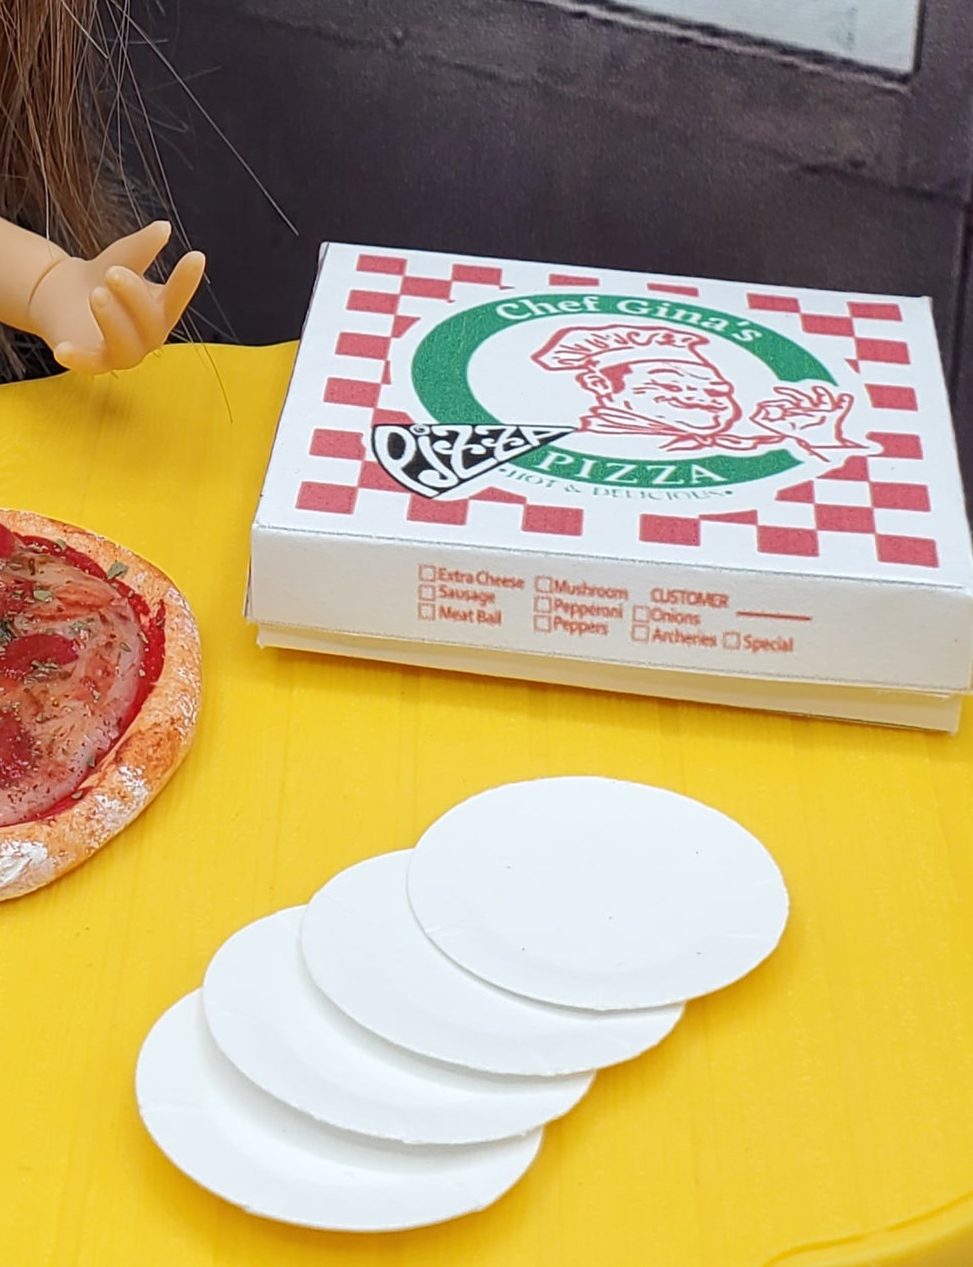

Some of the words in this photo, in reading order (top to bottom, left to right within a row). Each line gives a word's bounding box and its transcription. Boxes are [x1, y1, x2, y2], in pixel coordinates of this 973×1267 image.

[495, 295, 601, 322] Chef
[616, 299, 763, 343] Gina's
[534, 450, 729, 485] PIZZA
[437, 567, 474, 584] Extra
[476, 570, 525, 590] Cheese
[438, 585, 496, 606] Sausage
[554, 579, 629, 601] Mushroom
[650, 587, 729, 608] CUSTOMER
[438, 605, 474, 623] Meat
[477, 608, 502, 626] Ball
[553, 616, 609, 636] Peppers
[649, 607, 701, 626] Onions
[742, 634, 794, 653] Special
